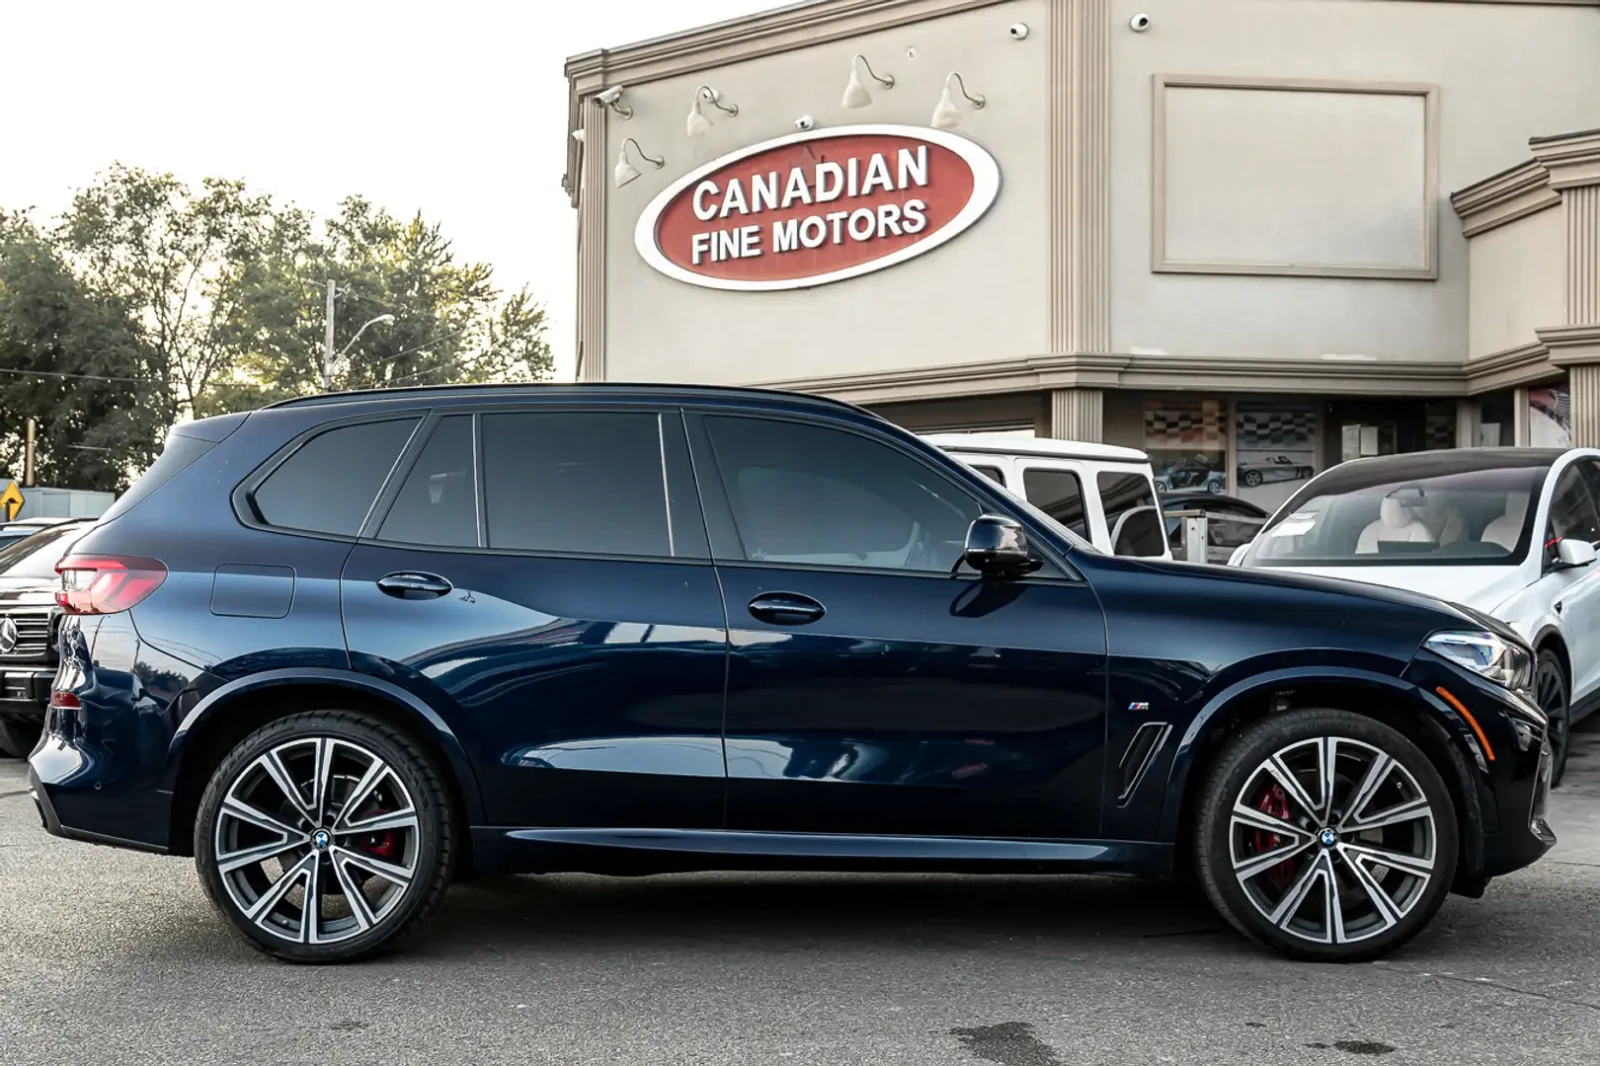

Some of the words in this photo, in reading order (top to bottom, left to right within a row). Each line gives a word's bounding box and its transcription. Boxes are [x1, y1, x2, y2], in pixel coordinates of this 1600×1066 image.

[692, 145, 928, 221] CANADIAN
[691, 225, 761, 265] FINE
[772, 199, 928, 253] MOTORS
